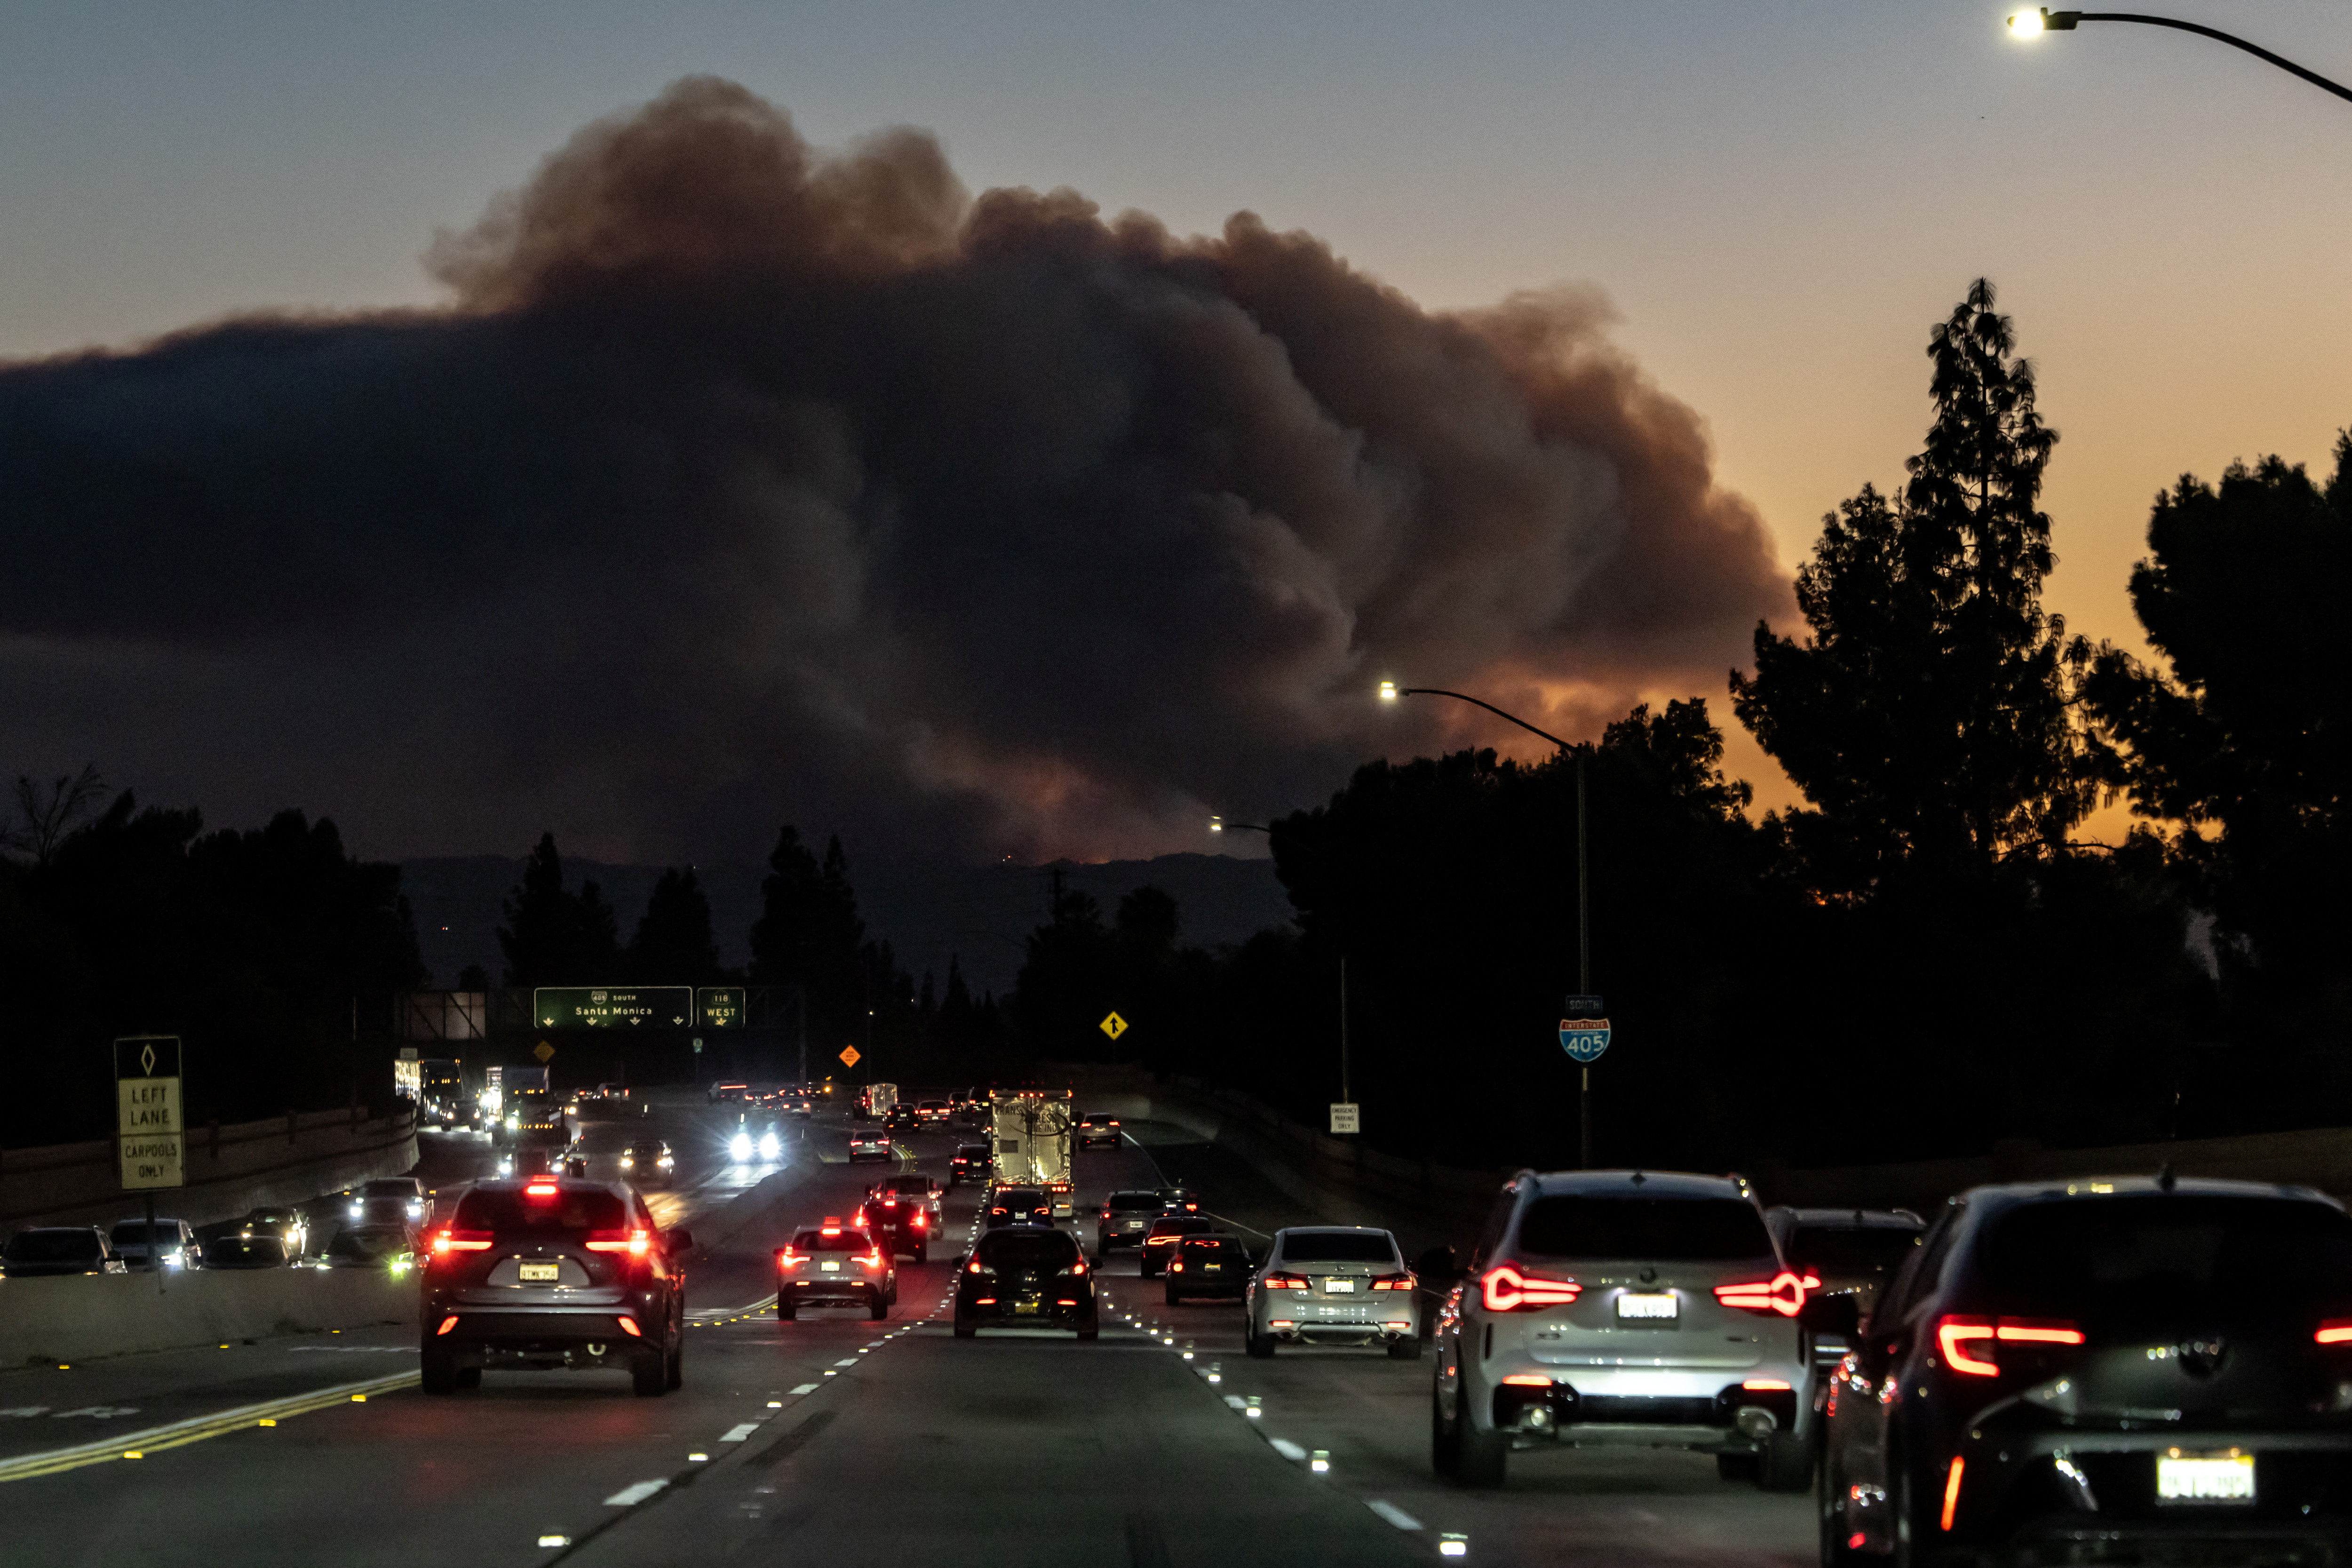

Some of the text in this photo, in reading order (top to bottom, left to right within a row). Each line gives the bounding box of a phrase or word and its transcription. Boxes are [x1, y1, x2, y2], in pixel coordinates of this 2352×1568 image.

[575, 1007, 652, 1015] Santa Monica
[1569, 1000, 1599, 1010] SOUTH
[1567, 1035, 1605, 1053] 405
[132, 1086, 167, 1104] LEFT
[130, 1108, 170, 1126] LANE
[125, 1143, 177, 1158] CARPOOLS
[139, 1163, 165, 1178] ONLY
